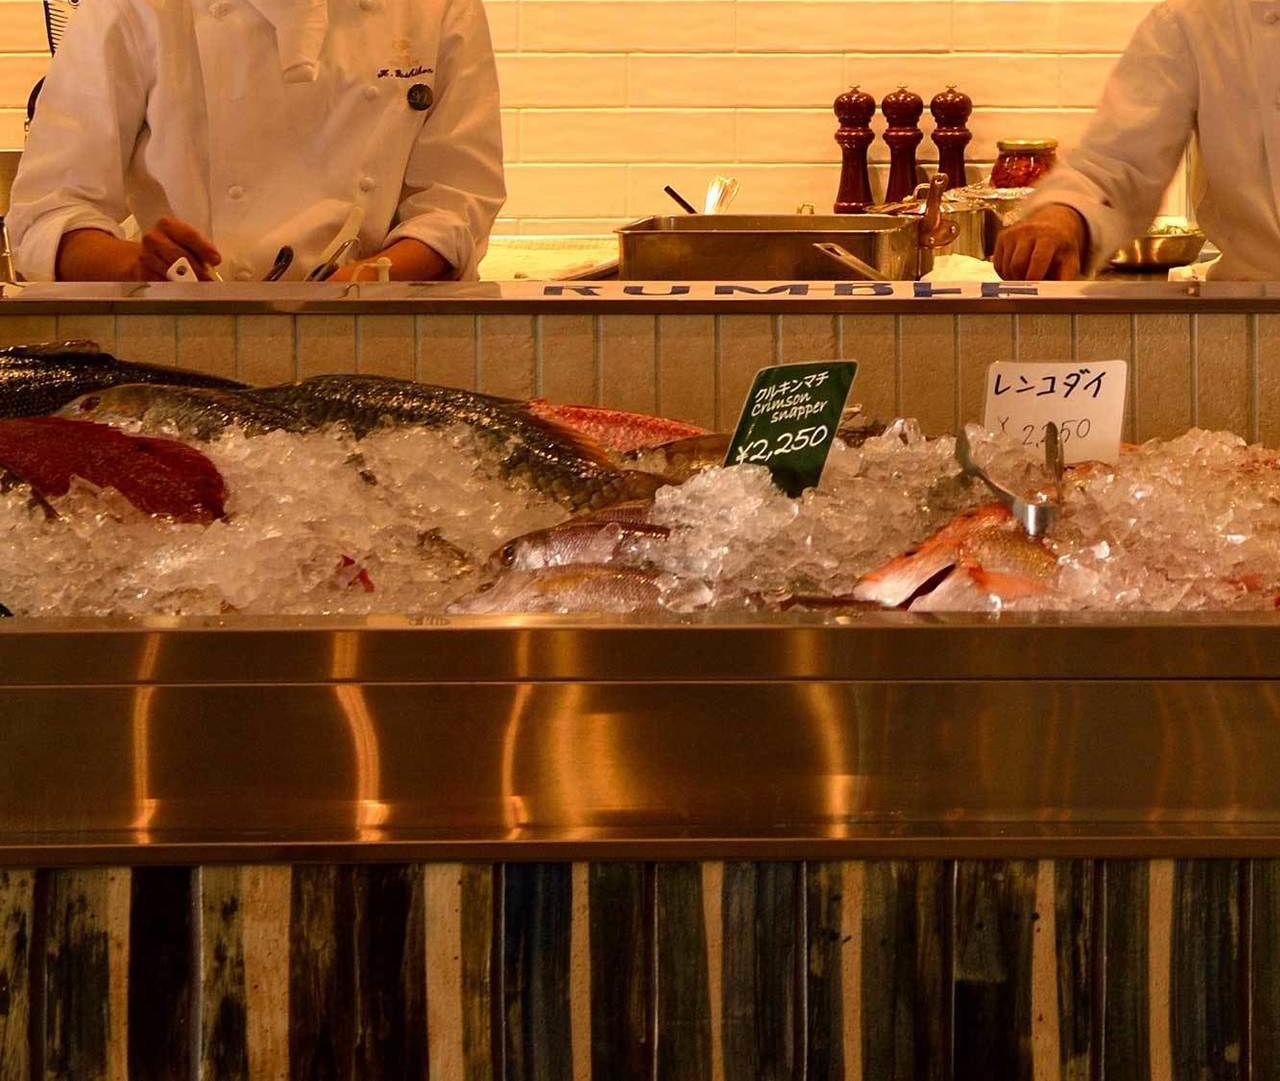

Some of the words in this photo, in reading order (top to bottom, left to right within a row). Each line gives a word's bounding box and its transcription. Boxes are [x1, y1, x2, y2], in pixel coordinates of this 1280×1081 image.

[994, 368, 1106, 399] レンコダイ
[735, 425, 828, 465] ¥2,250
